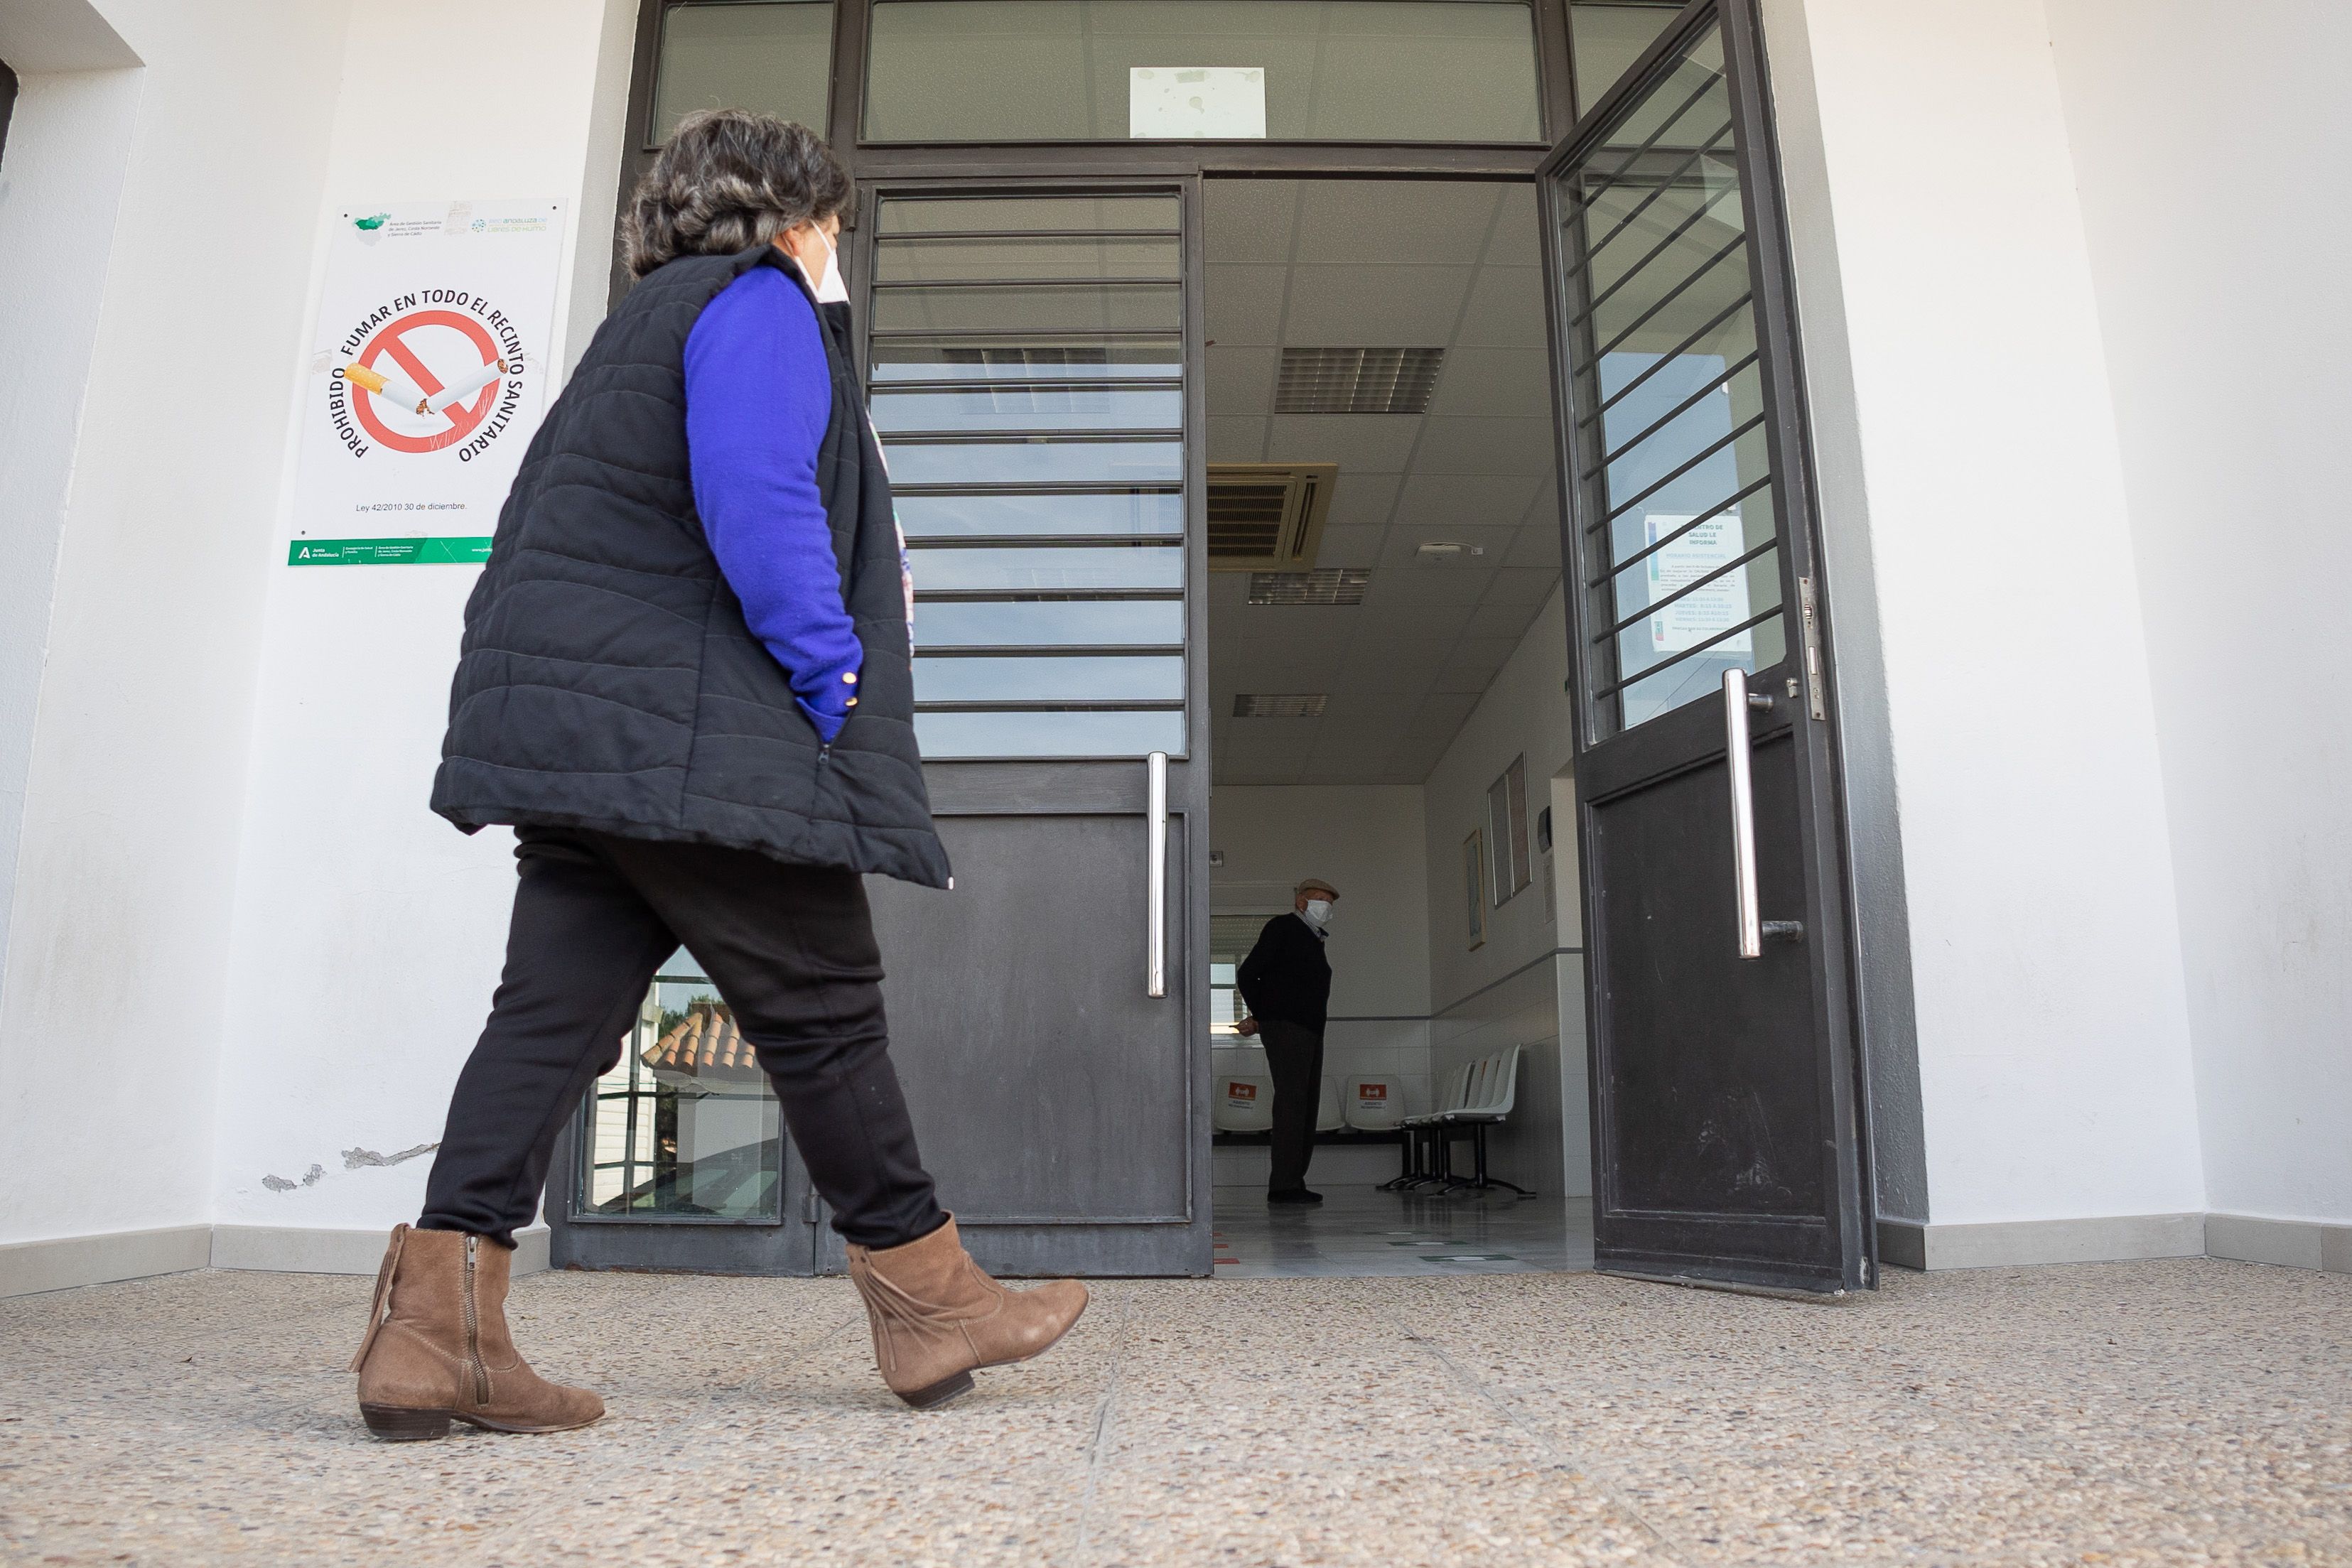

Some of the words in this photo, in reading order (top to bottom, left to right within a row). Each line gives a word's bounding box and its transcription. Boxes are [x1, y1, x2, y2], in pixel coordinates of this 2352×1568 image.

[394, 293, 416, 311] EN
[421, 289, 469, 306] TODO
[470, 297, 488, 315] EL
[340, 306, 392, 356] FUMAR
[487, 309, 524, 375] RECINTO
[329, 367, 369, 458] PROHIBIDO
[459, 380, 523, 462] SANITARIO
[356, 504, 370, 513] Ley
